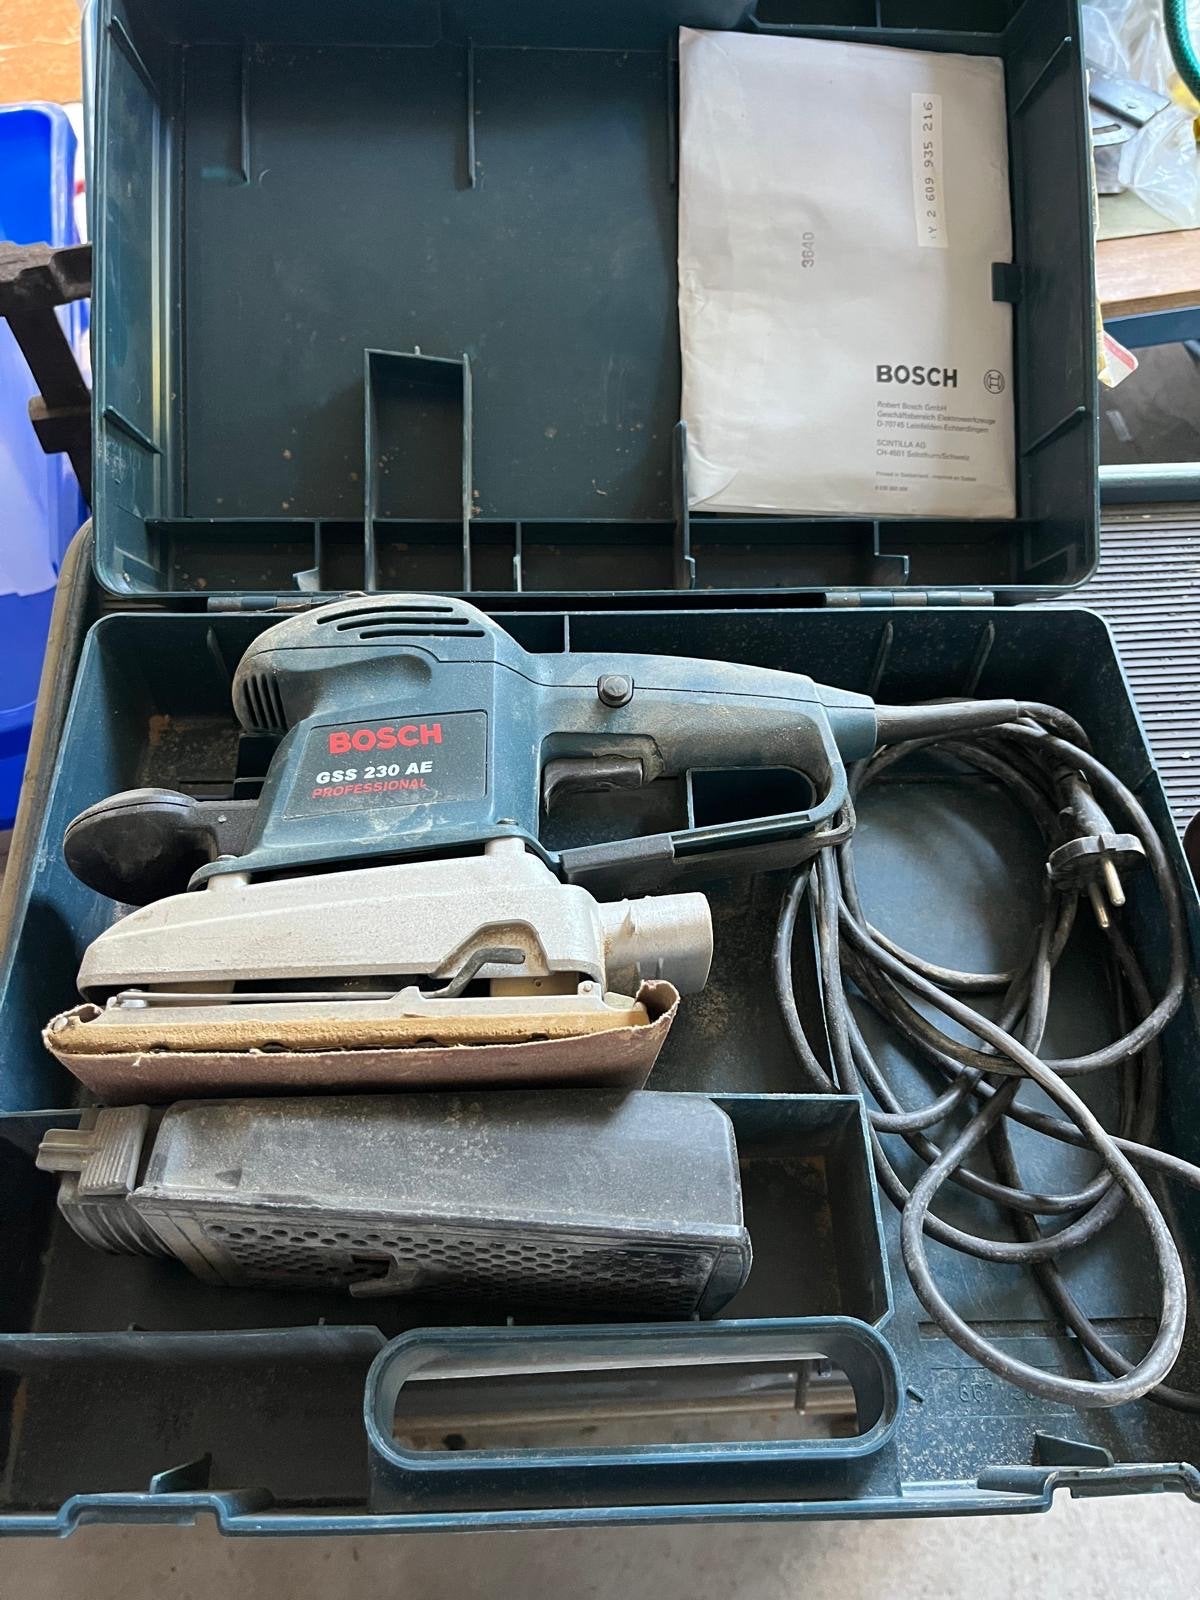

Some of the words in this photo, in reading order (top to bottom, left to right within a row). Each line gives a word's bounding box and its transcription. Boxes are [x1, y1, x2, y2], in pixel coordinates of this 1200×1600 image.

[922, 101, 934, 131] 216
[923, 141, 934, 168] 935
[925, 177, 936, 201] 609
[927, 210, 936, 218] 2
[801, 231, 815, 268] 3640
[876, 364, 958, 388] BOSCH
[877, 400, 901, 409] Robert
[902, 402, 923, 410] Bosch
[876, 439, 914, 448] SCINTILLA
[329, 723, 442, 754] BOSCH
[316, 768, 358, 784] GSS
[363, 764, 400, 779] 230
[405, 761, 433, 775] AE
[312, 778, 426, 799] PROFESSIONAL
